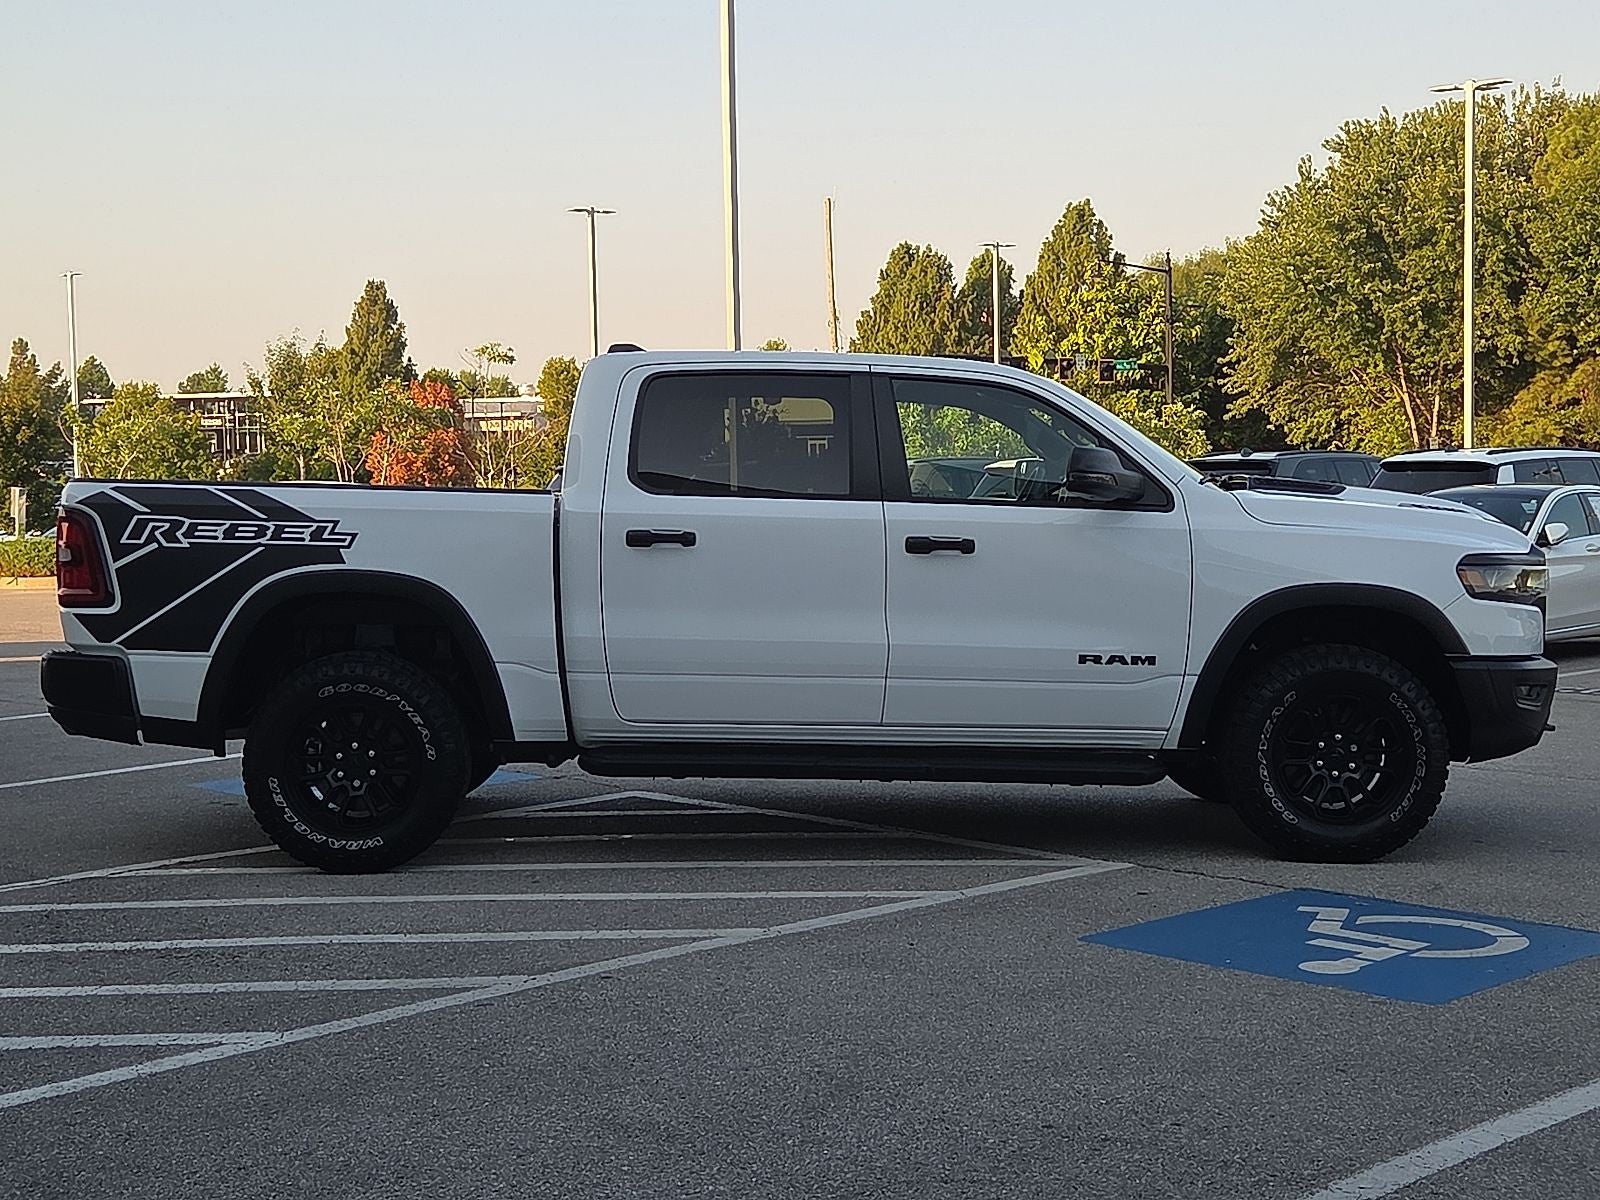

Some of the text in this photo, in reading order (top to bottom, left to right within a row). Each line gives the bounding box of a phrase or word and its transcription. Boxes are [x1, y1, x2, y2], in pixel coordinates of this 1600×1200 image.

[119, 514, 359, 549] REBEL
[1078, 654, 1157, 666] RAM
[318, 683, 436, 760] GOODYEAR
[1257, 691, 1299, 825] GOODYEAR
[1389, 692, 1426, 822] WRANGLER
[268, 776, 384, 850] WRANGLER
